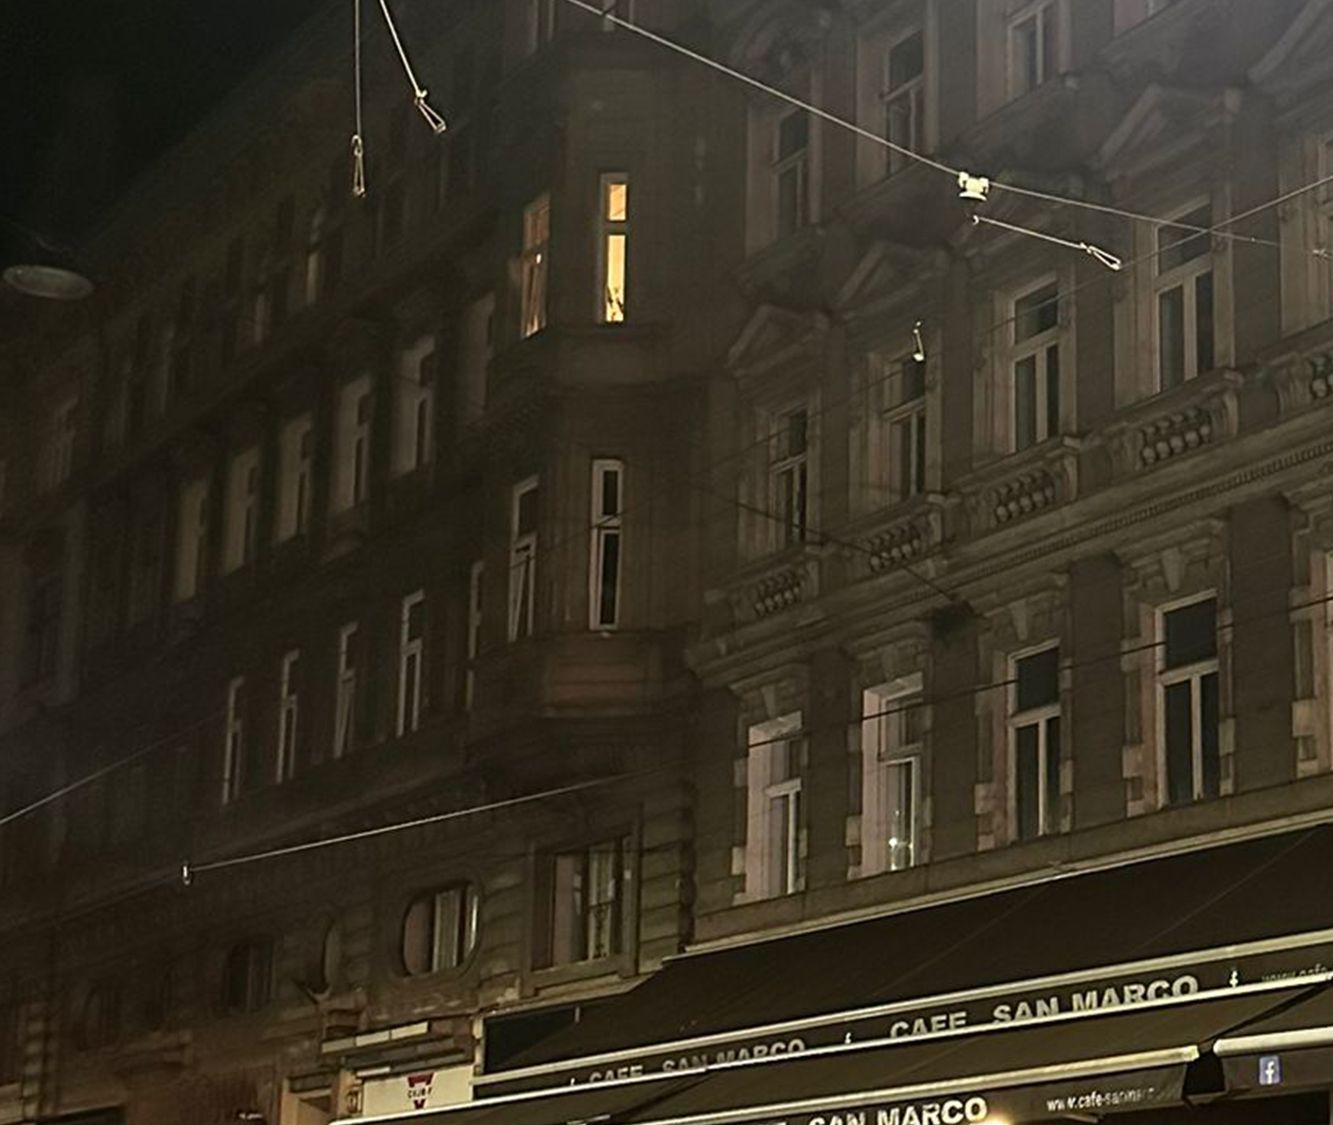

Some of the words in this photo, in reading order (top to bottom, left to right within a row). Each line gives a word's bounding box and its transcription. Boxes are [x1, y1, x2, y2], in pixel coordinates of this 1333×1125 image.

[890, 1011, 967, 1039] CAFE
[992, 997, 1059, 1026] SAN
[1072, 975, 1199, 1014] MARCO
